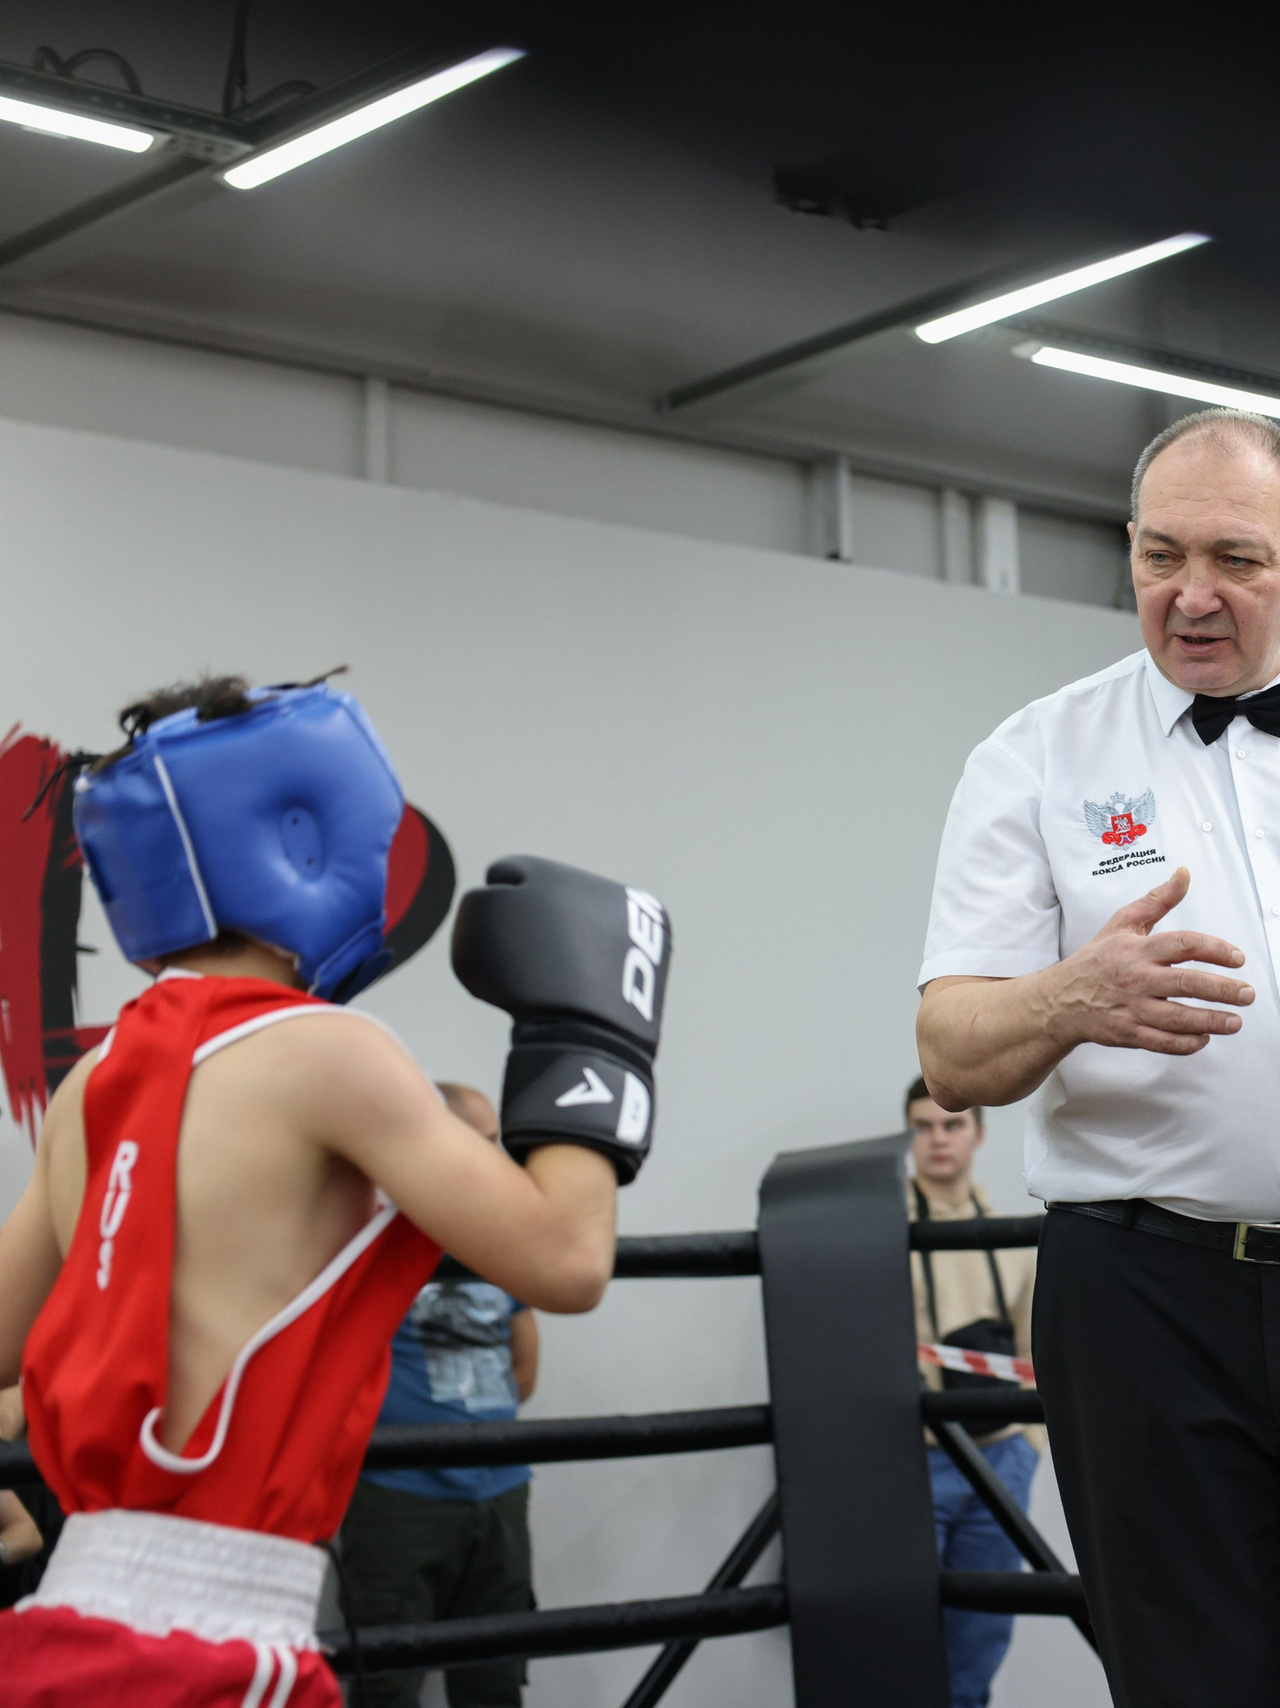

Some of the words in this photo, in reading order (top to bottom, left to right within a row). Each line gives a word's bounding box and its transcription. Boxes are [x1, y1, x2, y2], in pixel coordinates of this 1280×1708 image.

[1092, 864, 1124, 876] БОКСА
[1126, 855, 1166, 868] РОССИИ
[1098, 848, 1156, 867] ФЕДЕРАЦИЯ
